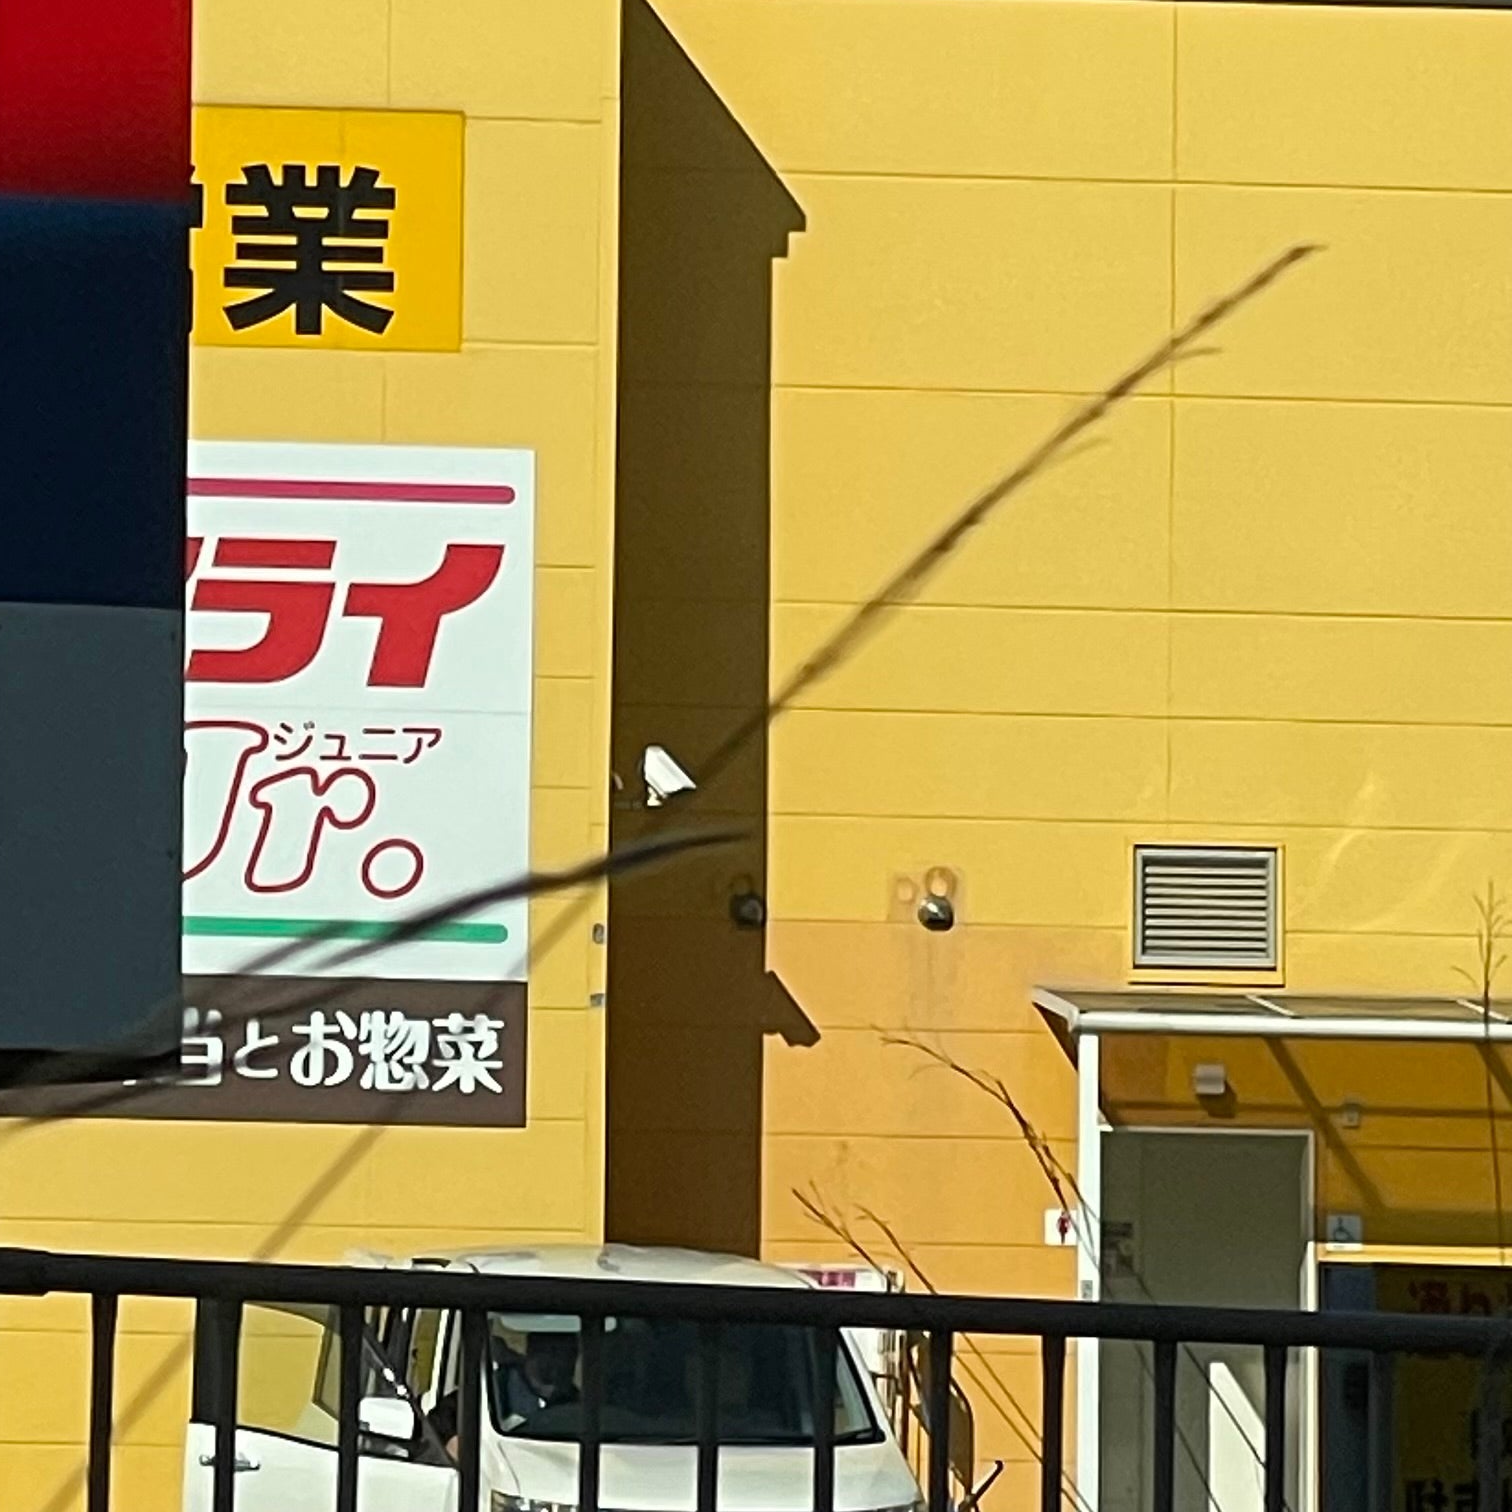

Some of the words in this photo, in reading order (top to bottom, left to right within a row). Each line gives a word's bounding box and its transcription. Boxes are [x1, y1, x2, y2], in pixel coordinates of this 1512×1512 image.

[190, 162, 396, 336] 業
[185, 536, 506, 688] ライ
[272, 721, 443, 765] ジュニア
